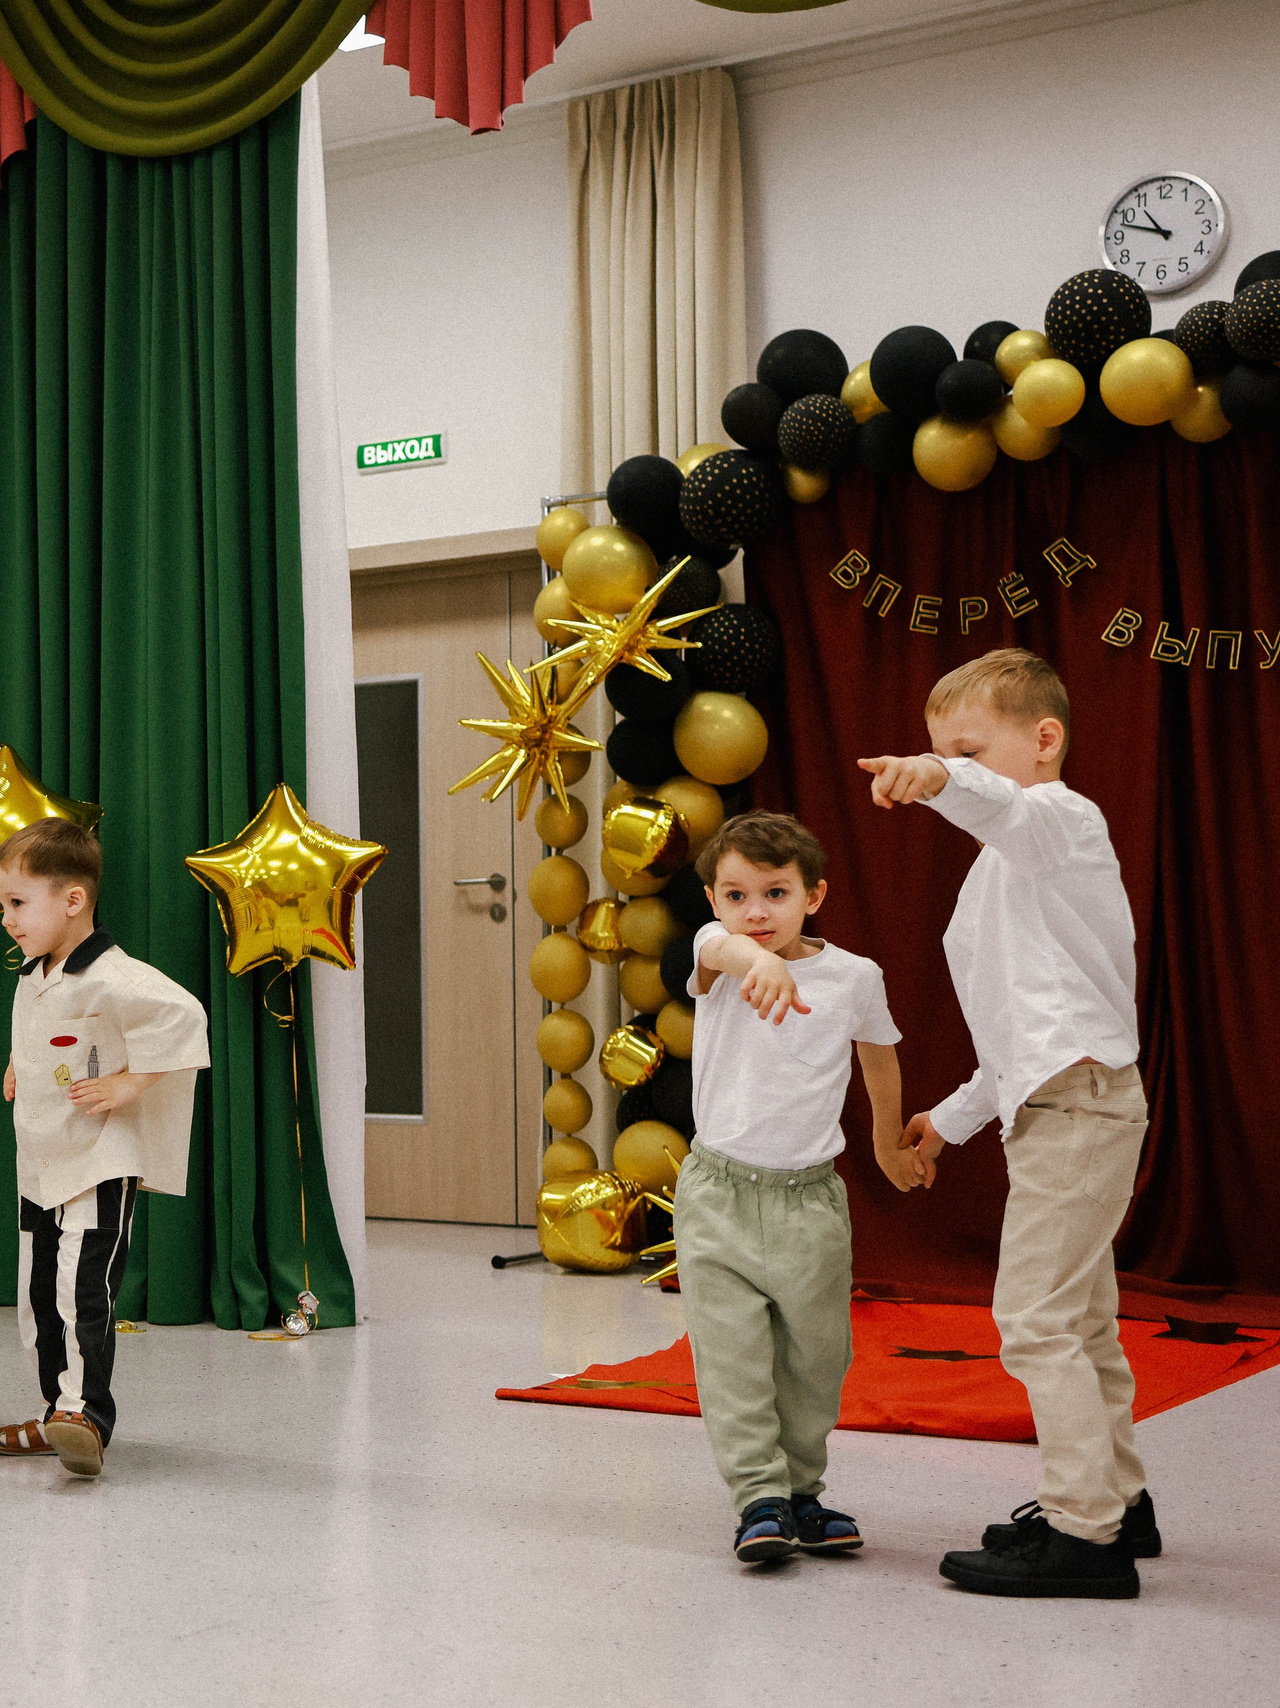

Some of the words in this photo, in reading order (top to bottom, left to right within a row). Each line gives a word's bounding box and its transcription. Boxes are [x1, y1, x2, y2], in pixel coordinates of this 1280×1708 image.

[1156, 183, 1173, 199] 12
[1181, 187, 1189, 202] 1
[1134, 192, 1147, 208] 11
[1194, 199, 1206, 215] 2
[1120, 207, 1136, 224] 10
[1201, 219, 1212, 235] 3
[1114, 230, 1125, 245] 9
[1193, 240, 1206, 256] 4
[1119, 249, 1131, 264] 8
[1177, 257, 1189, 272] 5
[1136, 262, 1146, 278] 7
[1156, 264, 1167, 280] 6
[363, 437, 436, 465] ВЫХОД
[829, 537, 1097, 635] ВПЕРЁД
[1101, 607, 1280, 670] ВЫПУ
